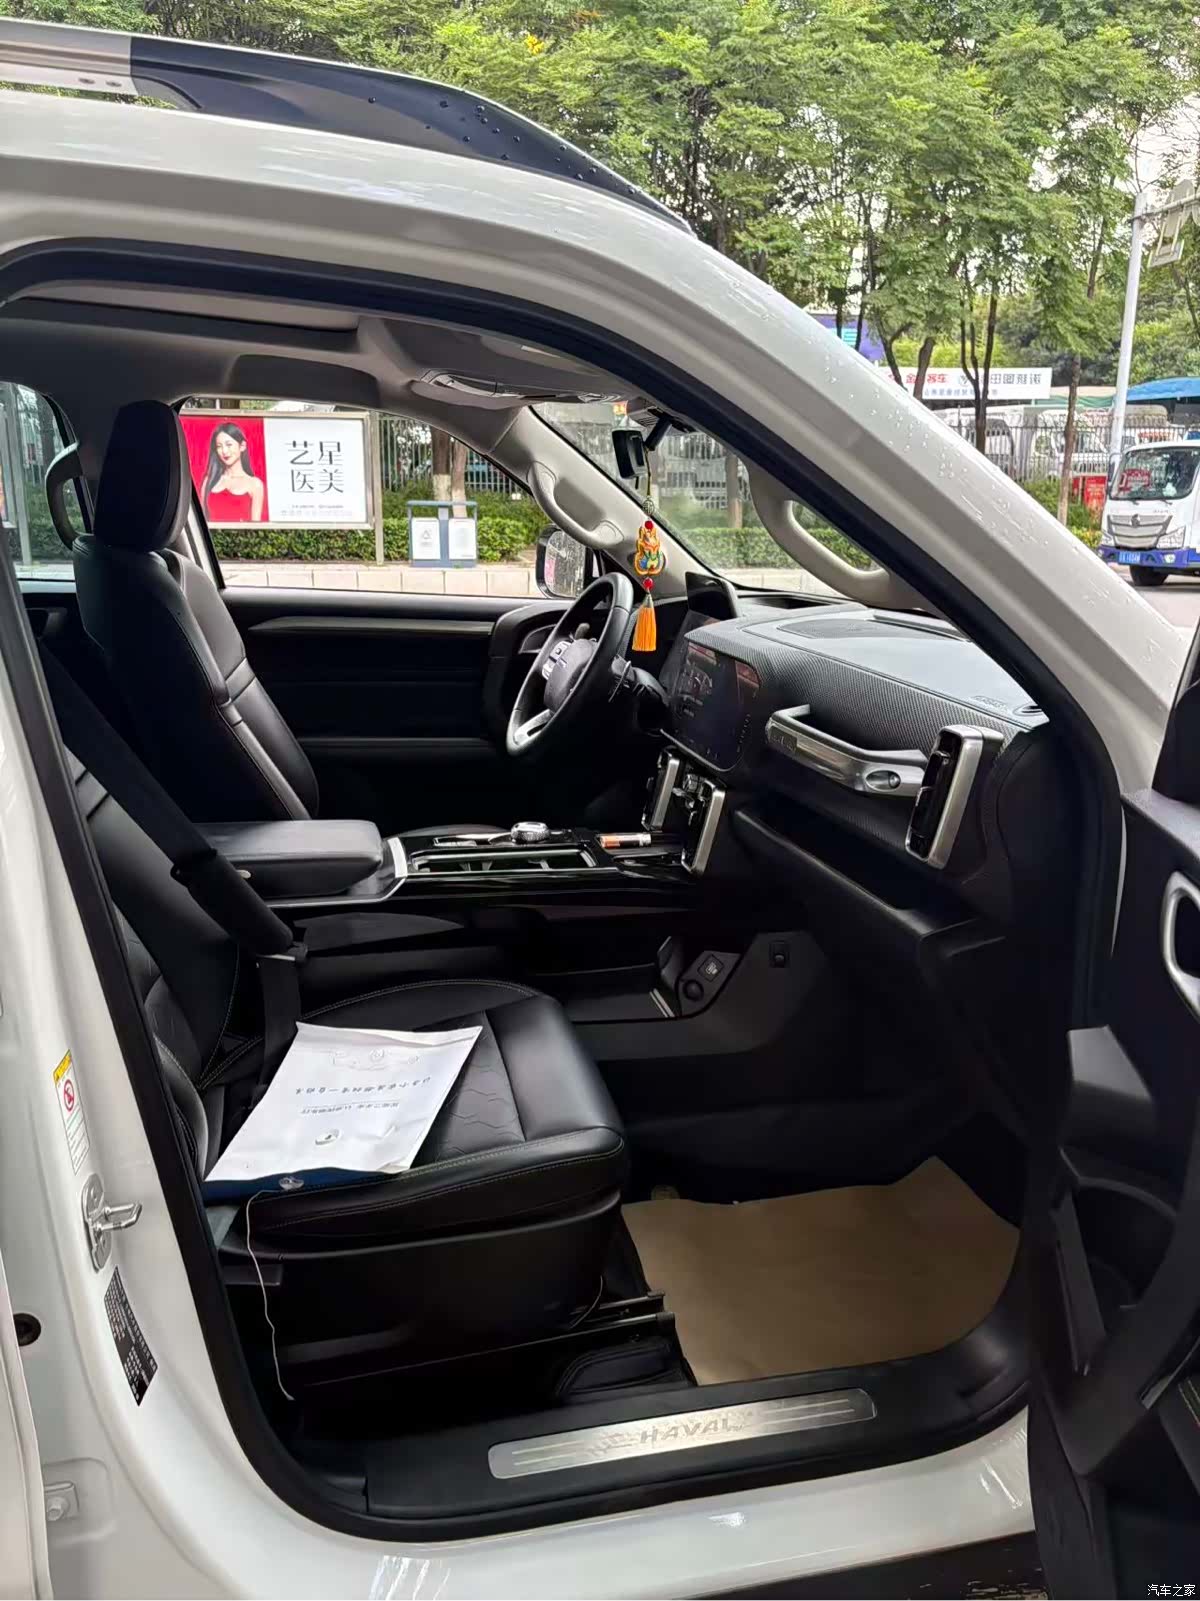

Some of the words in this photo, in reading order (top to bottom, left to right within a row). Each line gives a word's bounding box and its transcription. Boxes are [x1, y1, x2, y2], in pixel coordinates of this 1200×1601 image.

[285, 440, 344, 466] 艺星
[290, 468, 344, 493] 医美
[640, 1417, 731, 1443] HAVAL
